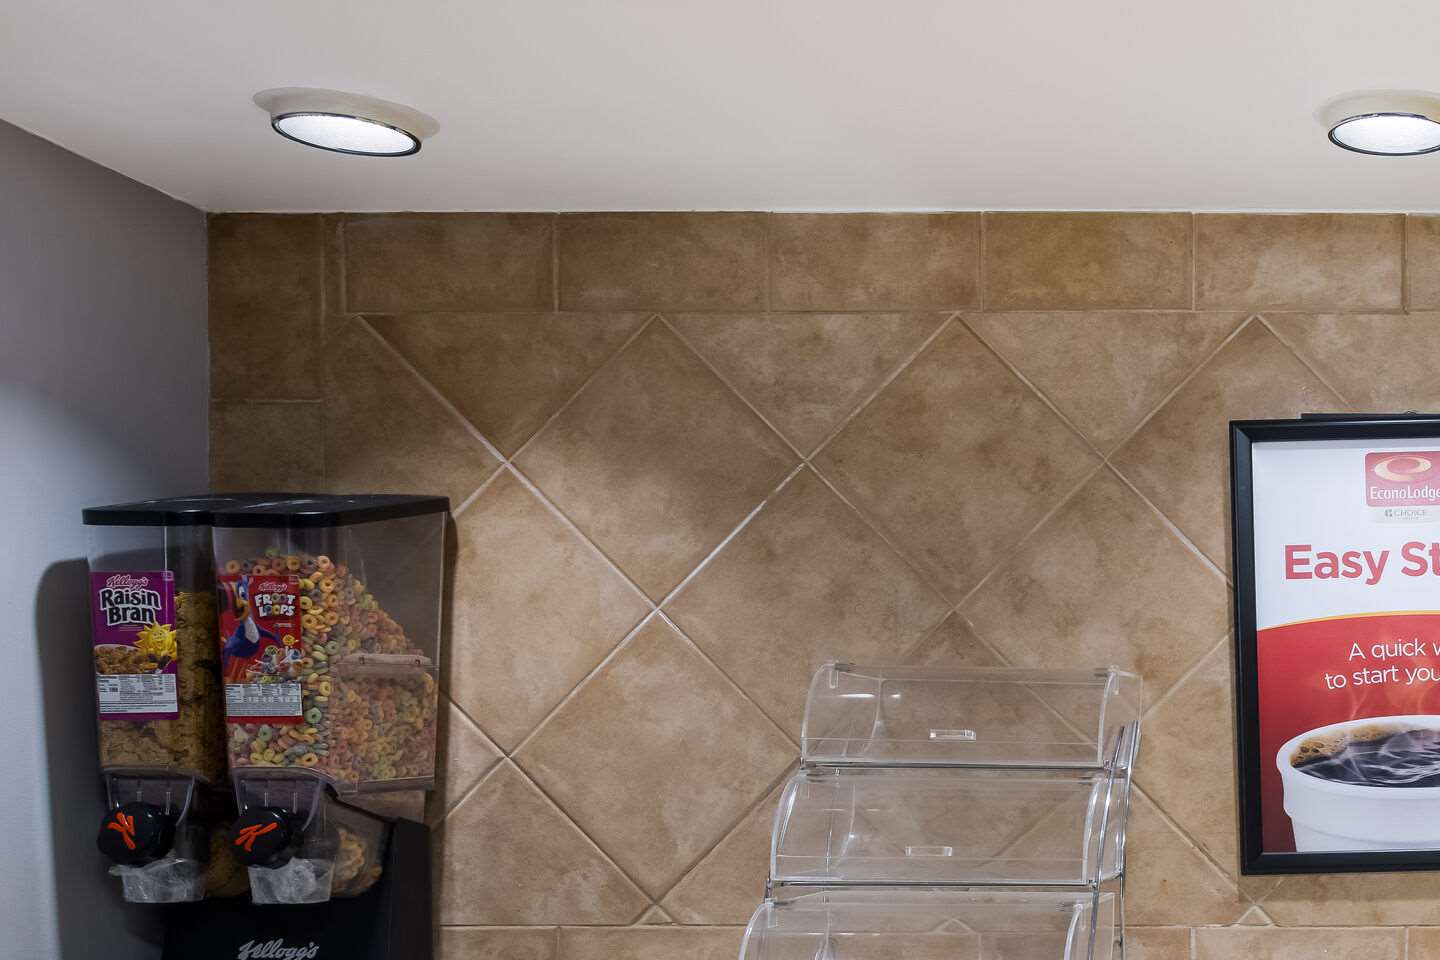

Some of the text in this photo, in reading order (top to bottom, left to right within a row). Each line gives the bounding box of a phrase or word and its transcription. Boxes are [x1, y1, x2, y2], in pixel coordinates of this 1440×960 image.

[1284, 543, 1390, 586] Easy
[99, 588, 162, 610] Raisin
[254, 593, 296, 607] FROOT
[107, 607, 157, 626] Bran
[258, 604, 296, 617] LOOPS
[1349, 643, 1366, 662] A
[1371, 638, 1426, 660] quick
[1325, 672, 1347, 689] to
[1352, 667, 1399, 686] start
